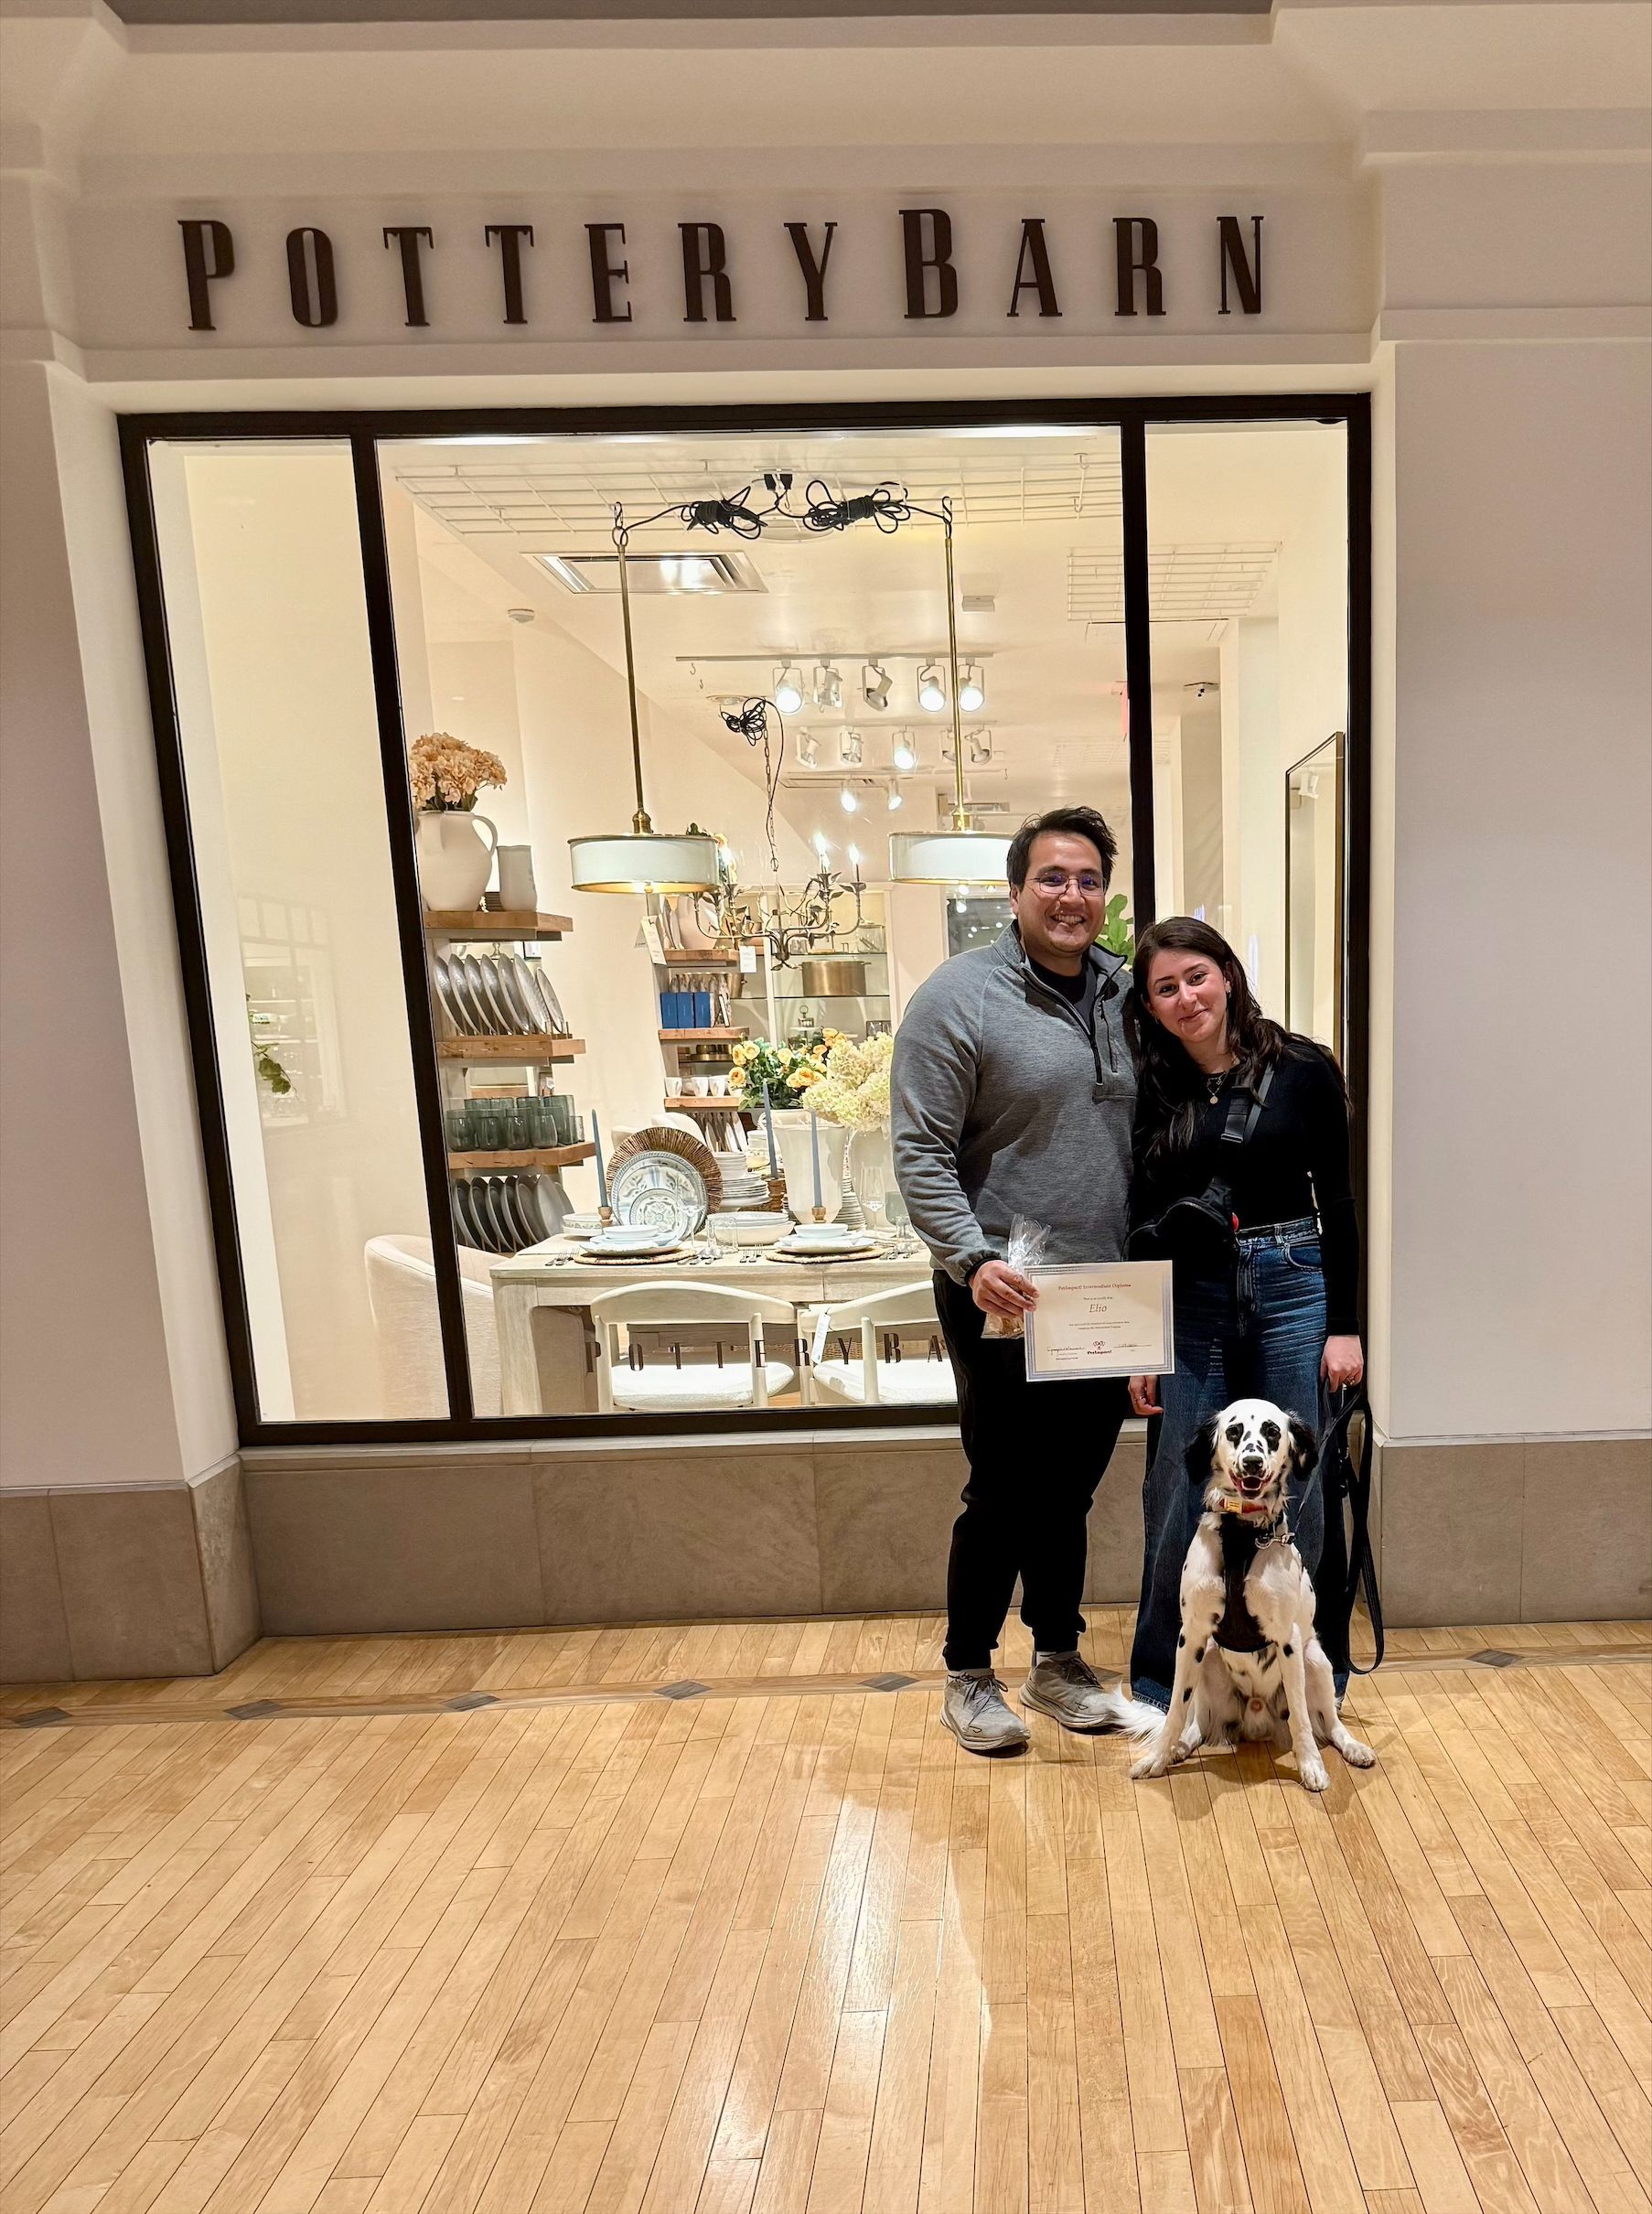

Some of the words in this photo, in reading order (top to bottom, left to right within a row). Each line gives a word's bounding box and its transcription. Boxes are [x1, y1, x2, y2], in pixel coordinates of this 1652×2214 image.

[177, 219, 838, 331] POTTERY
[897, 208, 1264, 318] BARN
[1089, 1304, 1108, 1313] Elio
[585, 1337, 853, 1373] POTTERY
[883, 1332, 943, 1364] BA
